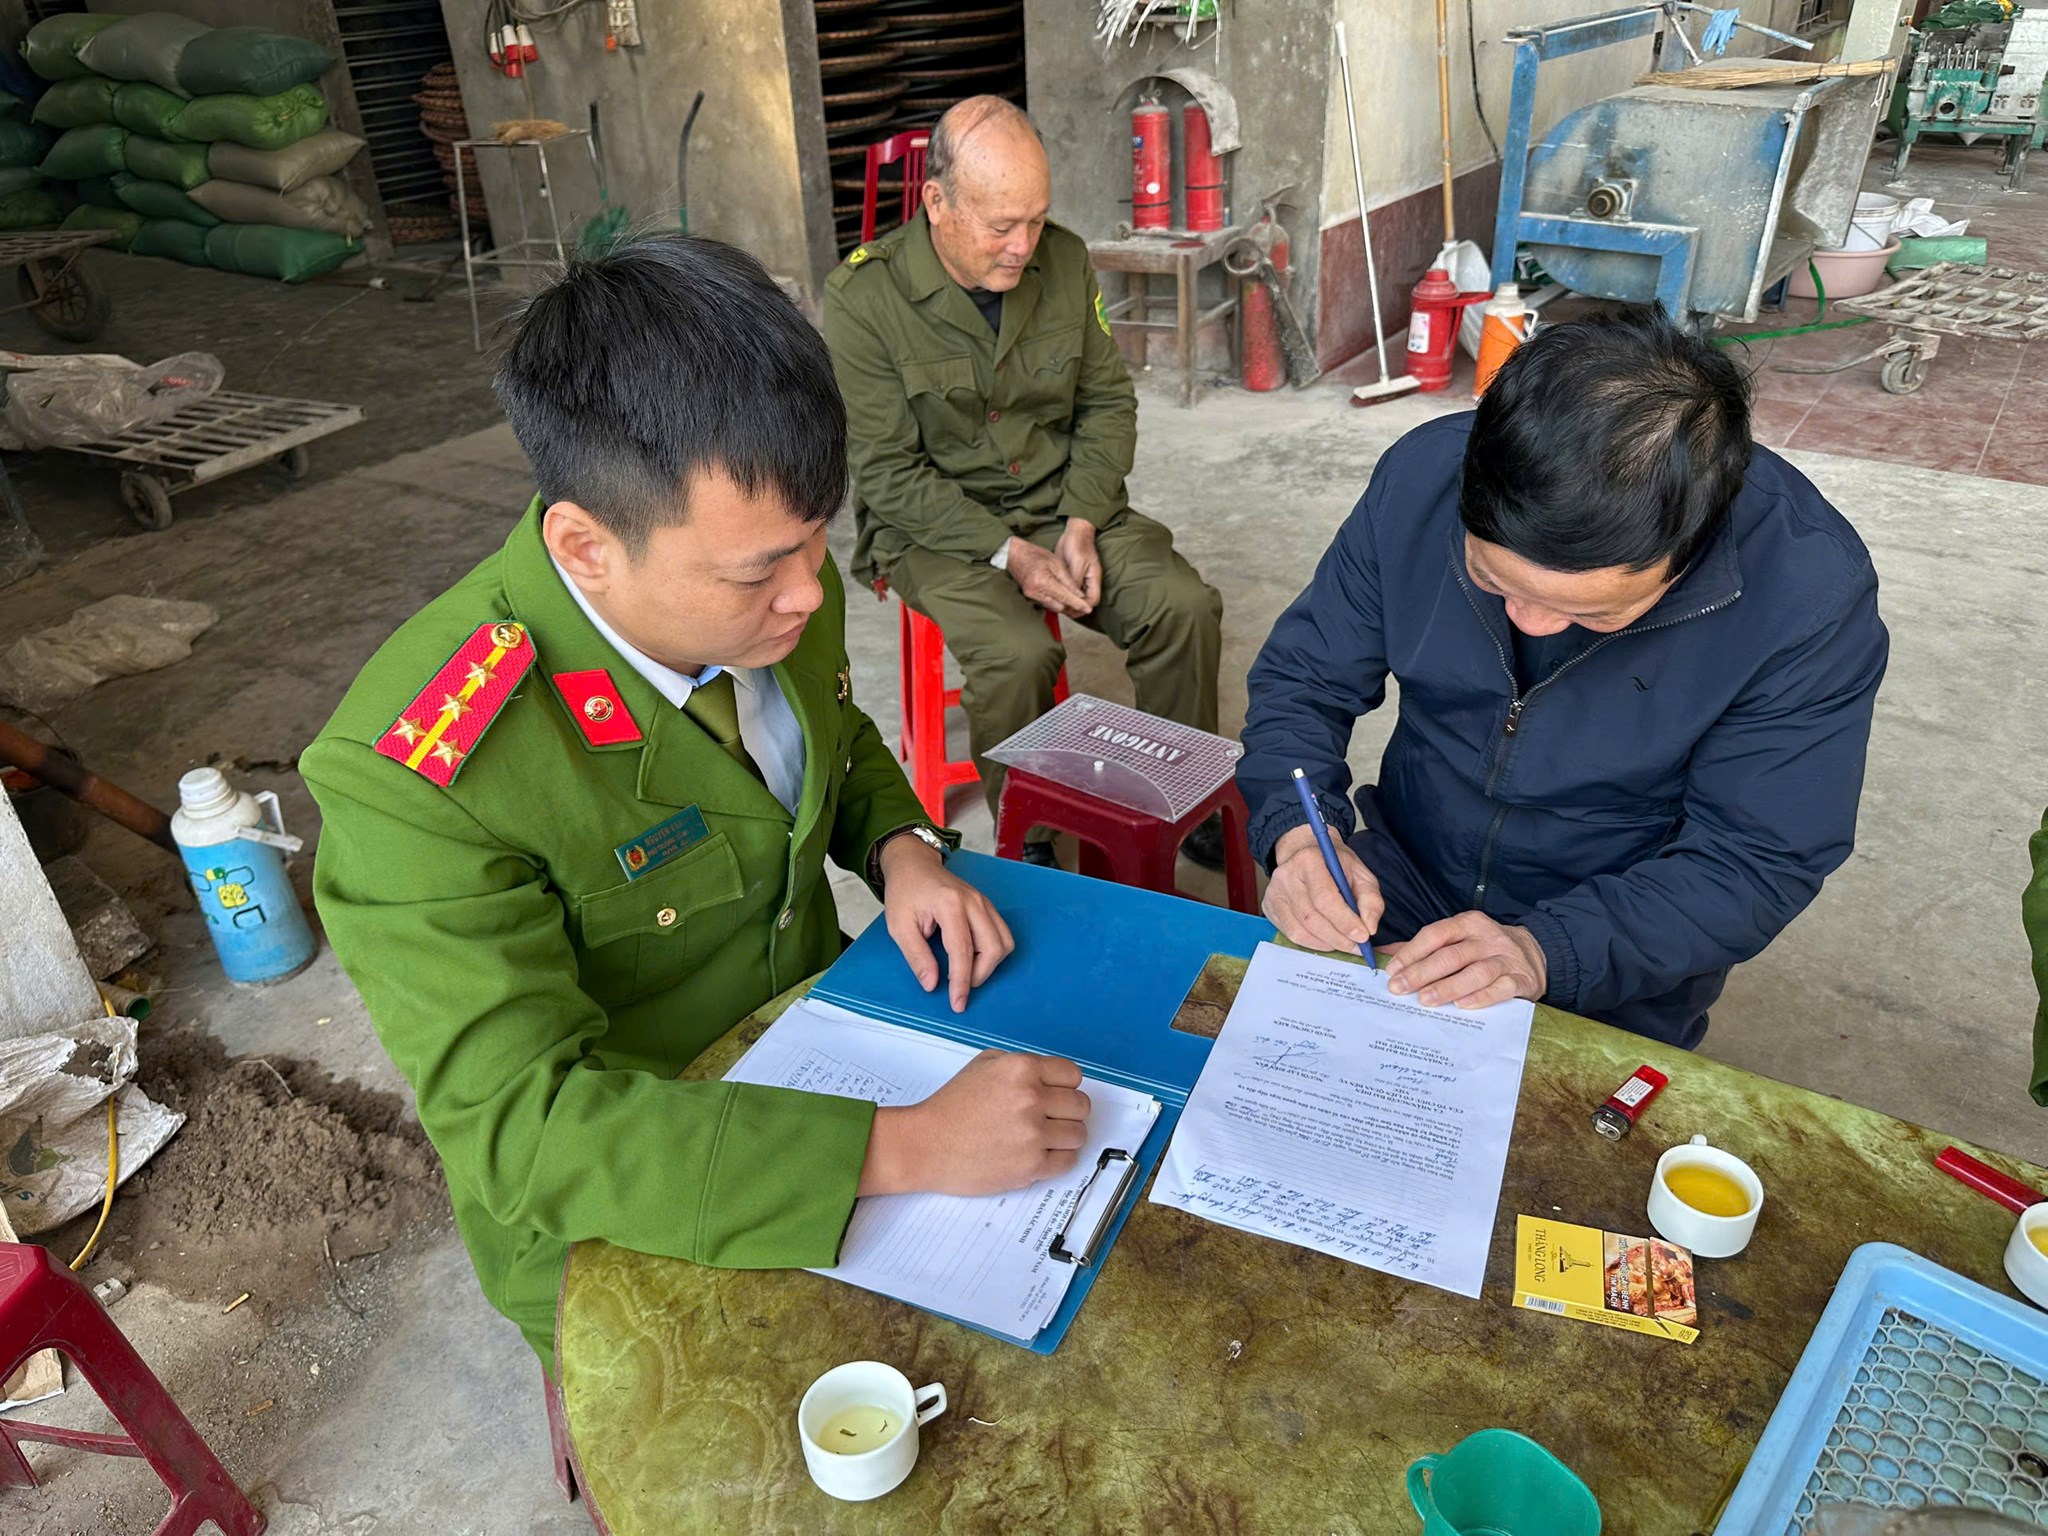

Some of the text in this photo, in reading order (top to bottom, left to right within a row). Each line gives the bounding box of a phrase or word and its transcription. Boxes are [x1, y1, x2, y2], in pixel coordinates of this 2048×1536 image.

[1088, 724, 1185, 762] ANTIGONE
[1532, 1257, 1546, 1282] LONG
[1619, 1252, 1630, 1274] THUỐC
[1609, 1285, 1617, 1307] MẠCH
[1618, 1290, 1629, 1309] BỆNH
